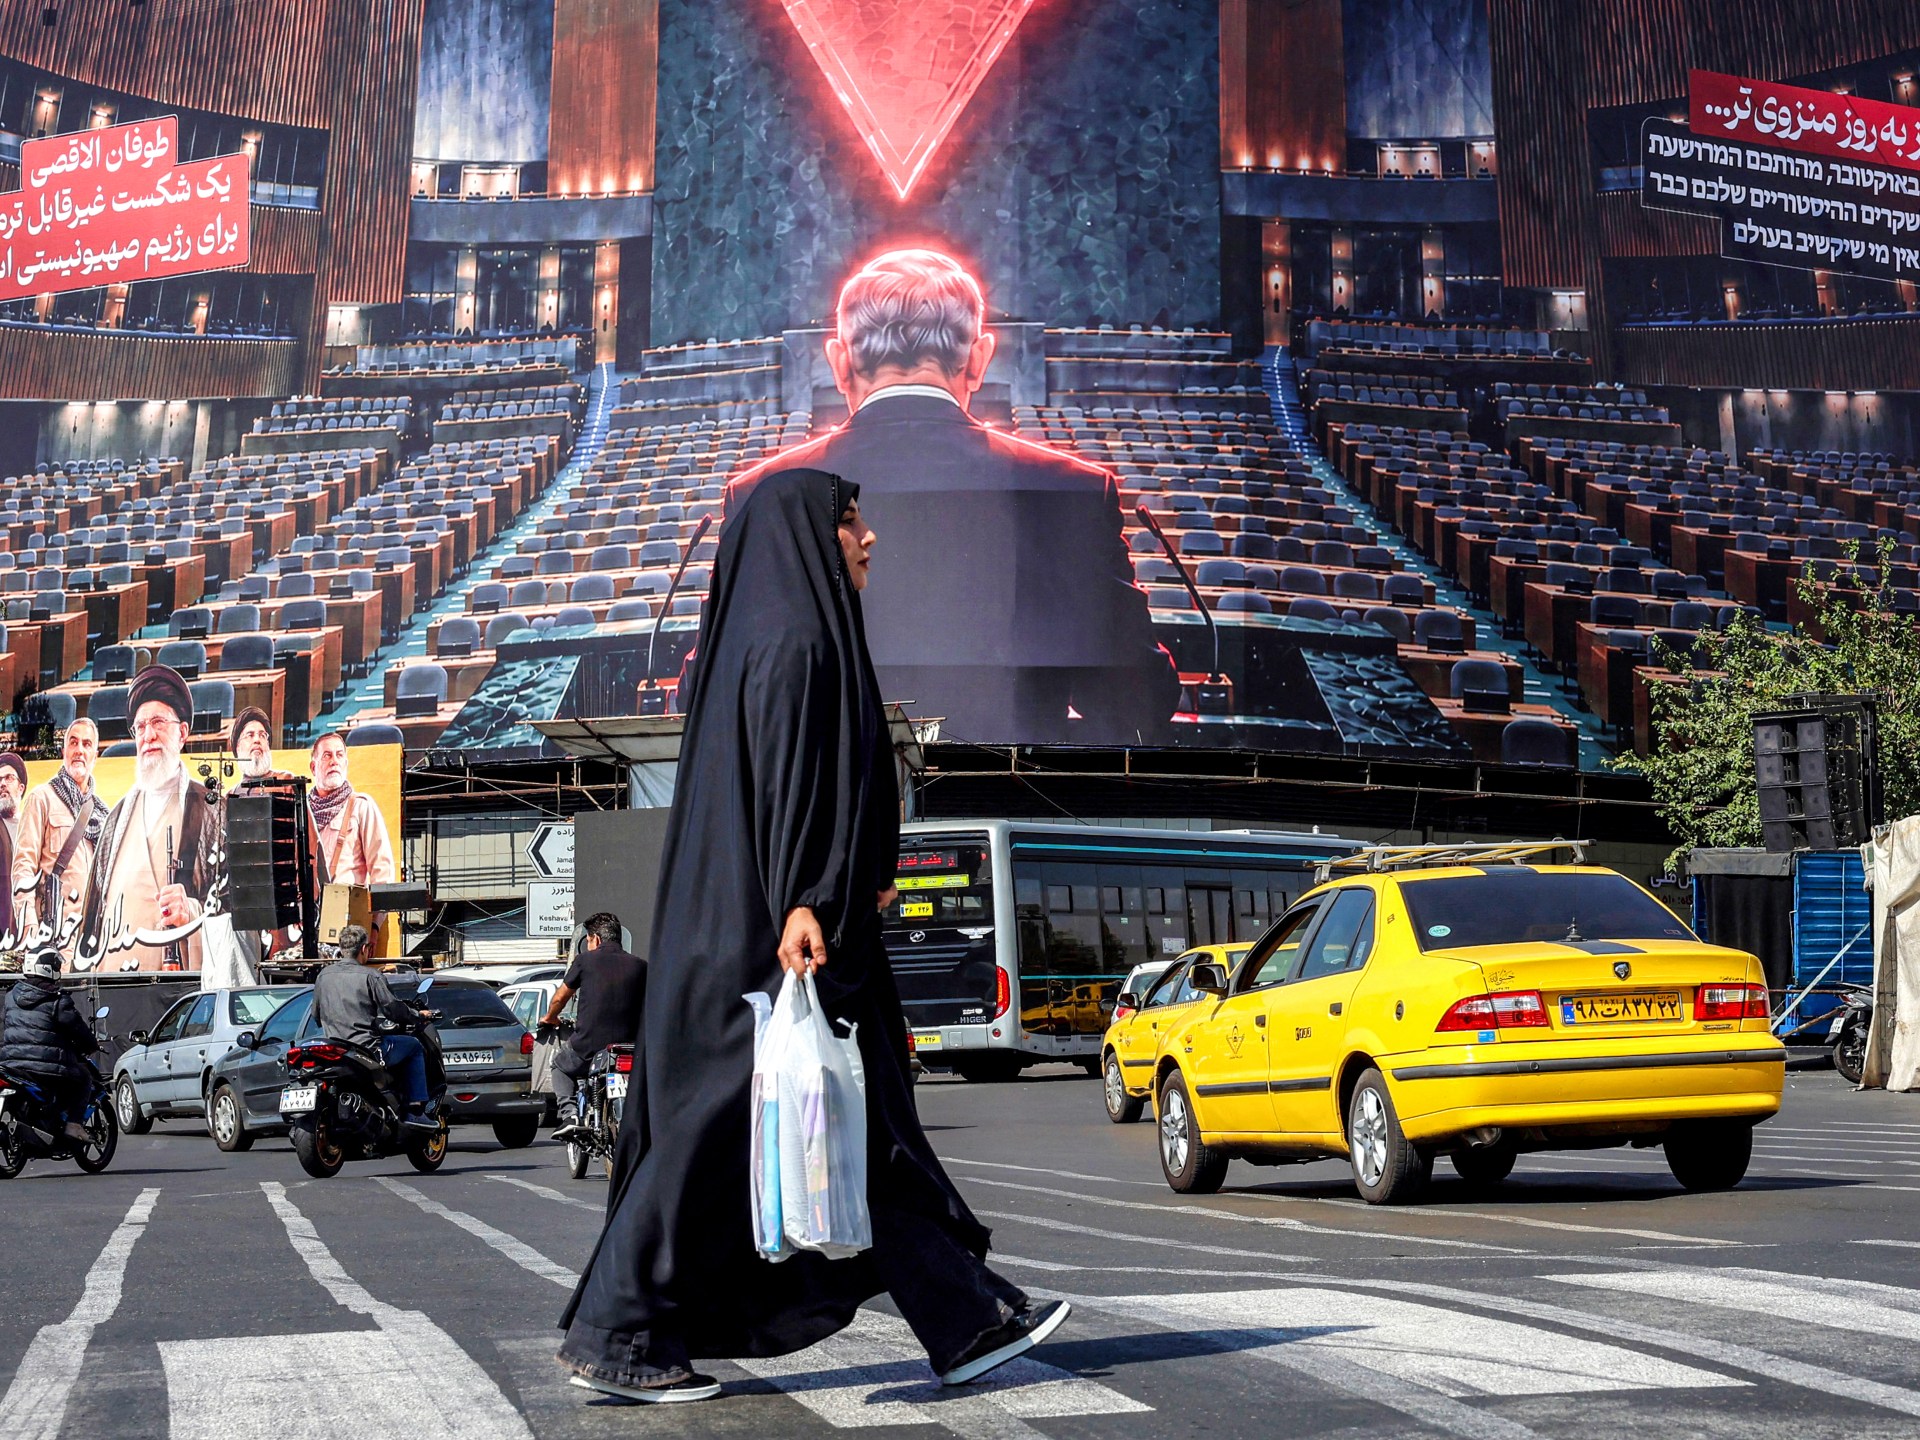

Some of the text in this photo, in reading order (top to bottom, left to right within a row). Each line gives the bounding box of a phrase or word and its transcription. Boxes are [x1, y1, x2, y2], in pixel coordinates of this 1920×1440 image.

[1836, 108, 1878, 153] روز
[1880, 115, 1907, 158] به
[30, 126, 170, 188] طوفان الاقصی
[1648, 133, 1920, 196] באוקטובר, מהותכם המרושעת
[111, 172, 192, 212] شکست
[196, 162, 232, 204] یک
[1649, 171, 1688, 197] כבר
[1691, 175, 1747, 205] שלכם
[27, 185, 107, 236] غیرقابل
[1749, 187, 1857, 224] ההיסטוריים
[144, 223, 192, 272] رژیم
[196, 212, 239, 257] برای
[1733, 217, 1920, 273] אין מי שיקשיב בעולם
[16, 237, 140, 287] صهیونیستی
[960, 1015, 987, 1024] HIGER
[1657, 1000, 1677, 1017] ۲۲
